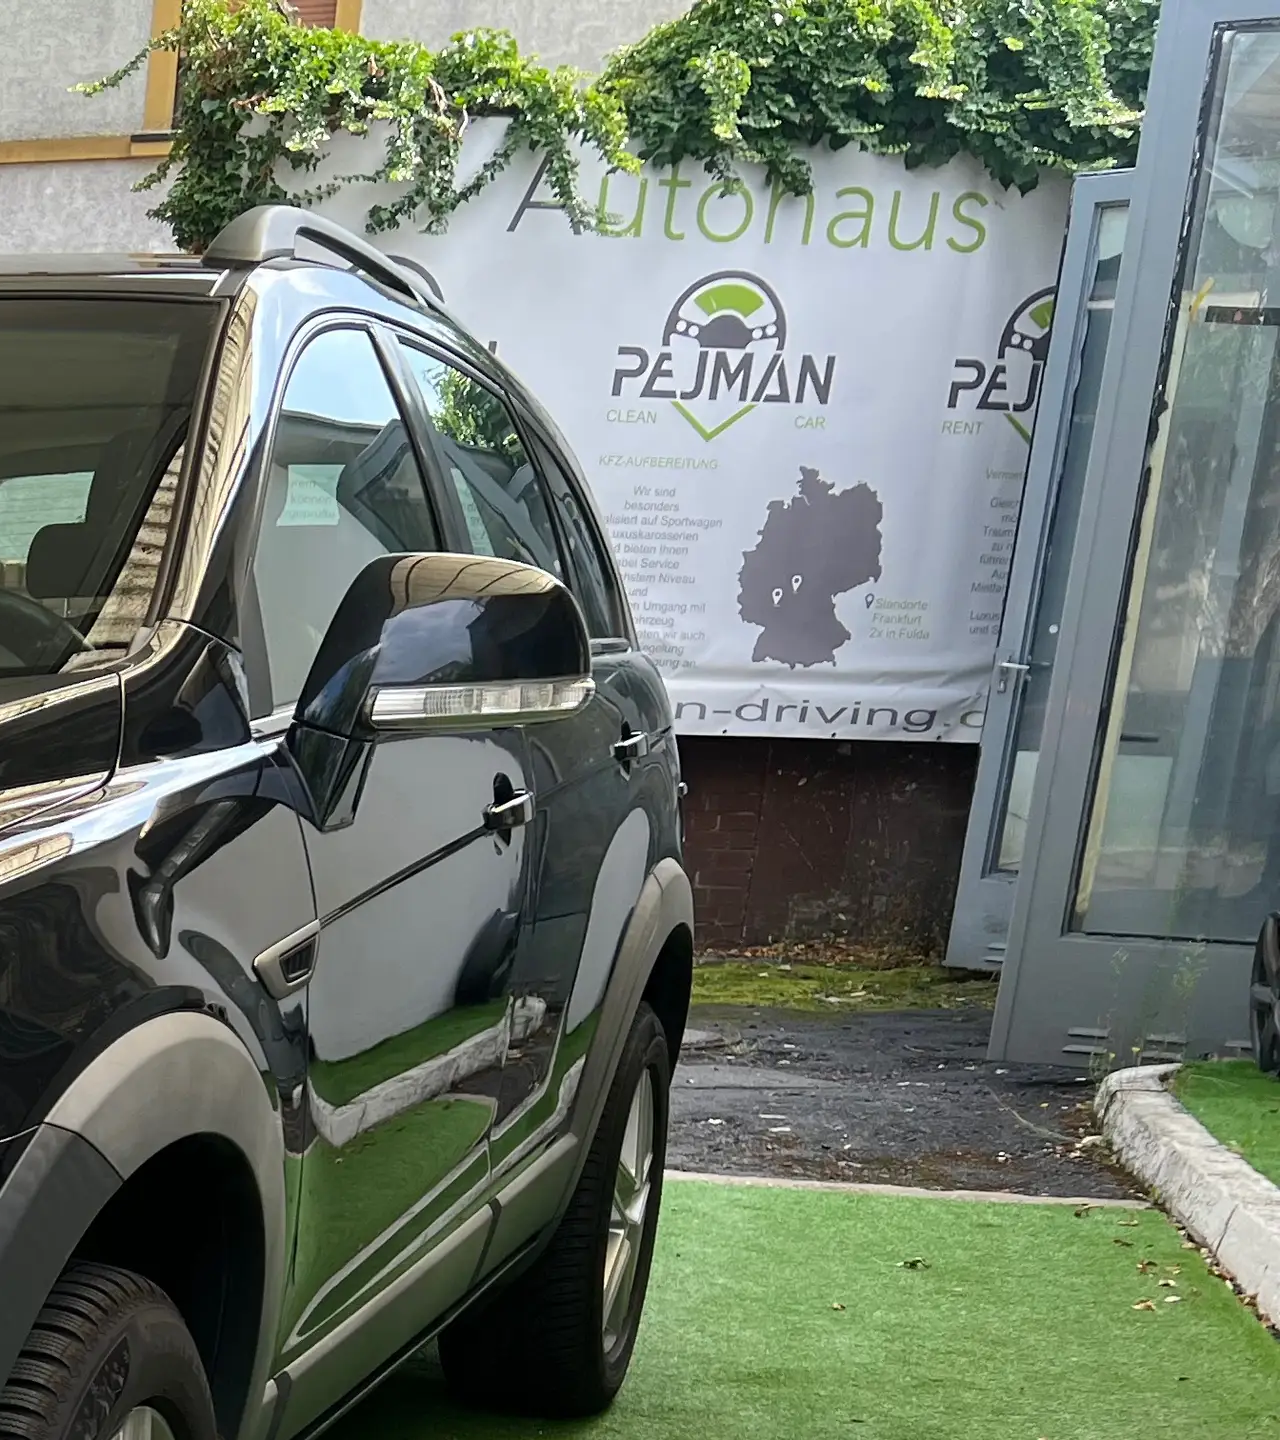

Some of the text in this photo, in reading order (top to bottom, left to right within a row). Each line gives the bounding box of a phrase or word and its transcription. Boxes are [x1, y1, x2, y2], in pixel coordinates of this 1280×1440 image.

[506, 154, 988, 253] Autohaus
[611, 346, 836, 404] PEJMAN
[947, 359, 1042, 412] PEJ
[606, 409, 657, 424] CLEAN
[794, 415, 827, 430] CAR
[941, 420, 984, 435] RENT
[599, 455, 718, 470] KFZ-AUFBEREITUNG
[633, 485, 676, 498] Wir sind
[624, 500, 680, 512] besonders
[604, 513, 723, 530] alisiert auf Sportwagen
[612, 529, 699, 541] uxuskarosserien
[984, 526, 1014, 537] Traum
[624, 543, 656, 555] bieten
[660, 544, 688, 556] Ihnen
[619, 558, 680, 569] bei Service
[621, 572, 696, 584] hstem Niveau
[643, 602, 687, 614] Umgang
[690, 603, 706, 613] mit
[875, 597, 928, 610] Standorte
[635, 616, 675, 627] hrzeug
[872, 612, 922, 625] Frankfurt
[663, 630, 678, 639] wir
[681, 631, 706, 641] auch
[869, 627, 930, 640] 2x in Fulda
[643, 645, 684, 656] egelung
[675, 698, 984, 733] n-driving.
